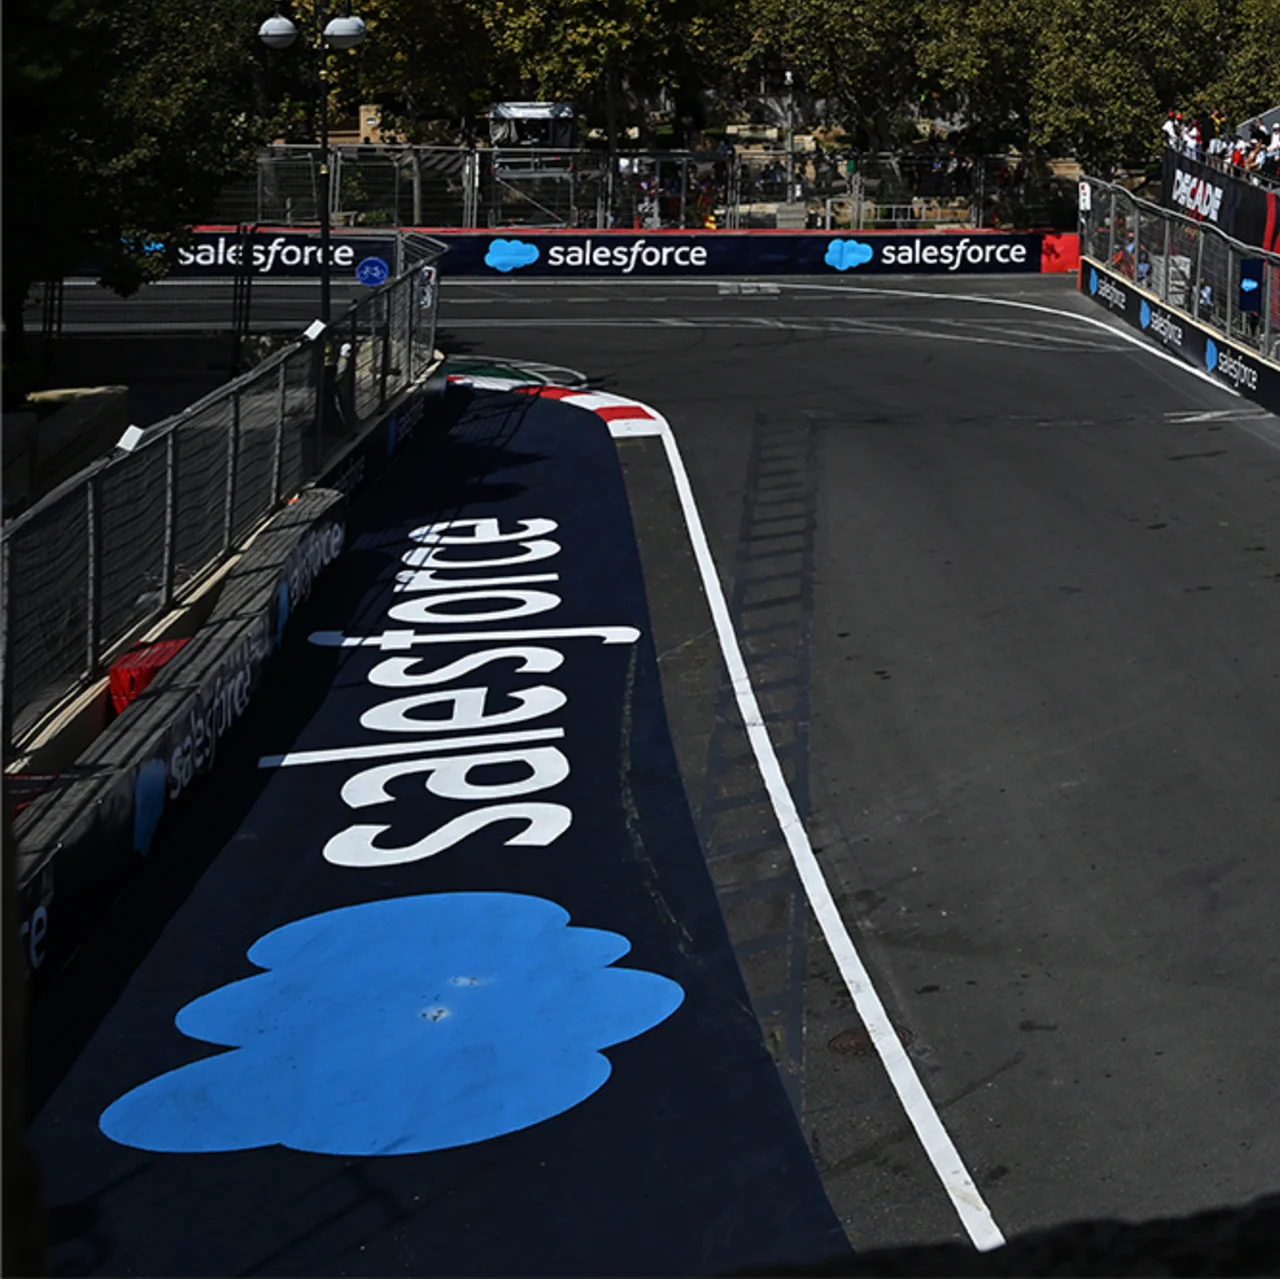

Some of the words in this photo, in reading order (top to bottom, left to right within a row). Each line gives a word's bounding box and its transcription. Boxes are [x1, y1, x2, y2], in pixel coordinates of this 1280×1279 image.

[1172, 169, 1223, 222] DECADE
[548, 240, 707, 273] salesforce
[881, 238, 1027, 271] salesforce
[257, 518, 641, 868] salesforce
